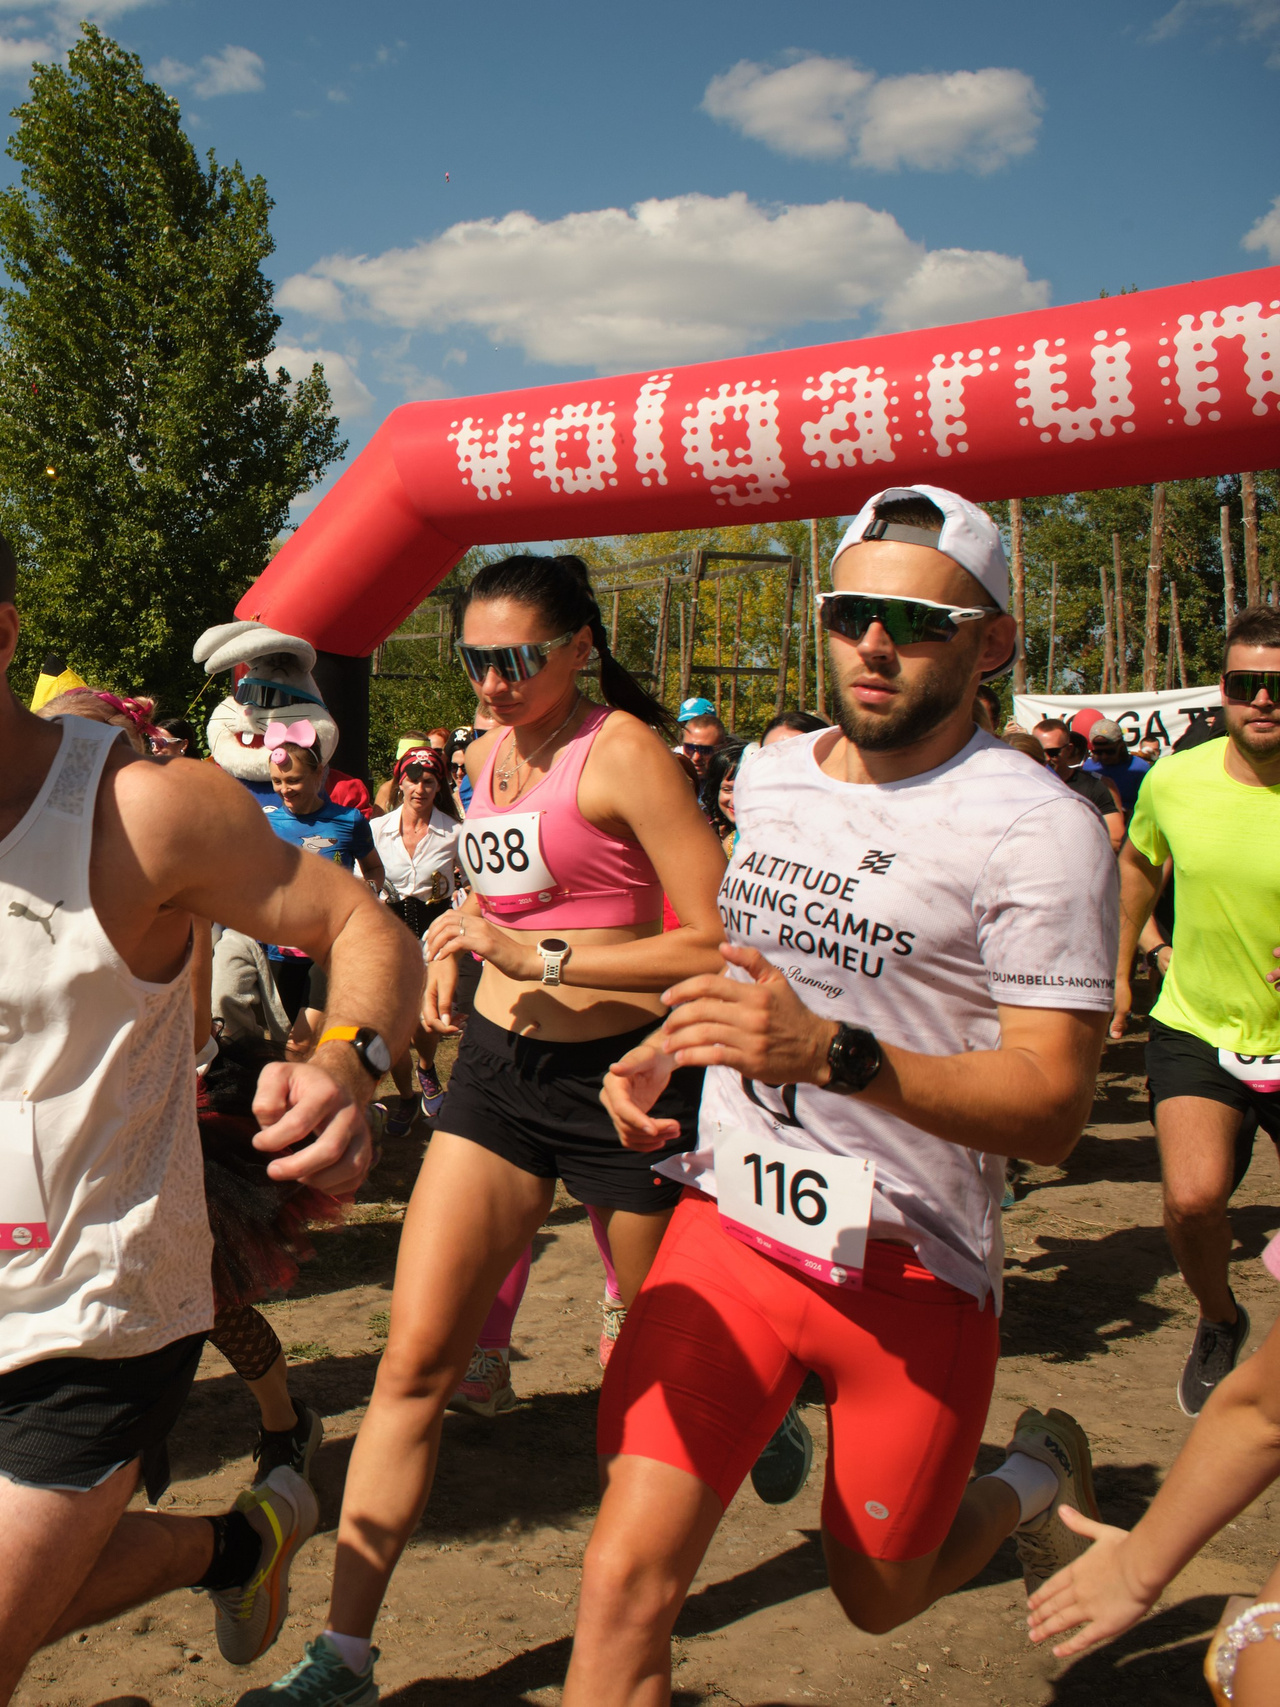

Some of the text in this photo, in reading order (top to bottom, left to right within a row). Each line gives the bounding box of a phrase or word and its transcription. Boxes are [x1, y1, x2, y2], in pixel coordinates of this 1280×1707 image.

[447, 300, 1280, 507] volgarun
[465, 828, 529, 874] 038
[740, 851, 860, 902] ALTITUDE
[778, 924, 884, 979] ROMEU
[804, 901, 915, 956] CAMPS
[788, 965, 845, 999] Running
[743, 1152, 828, 1226] 116
[804, 1259, 822, 1271] 2024
